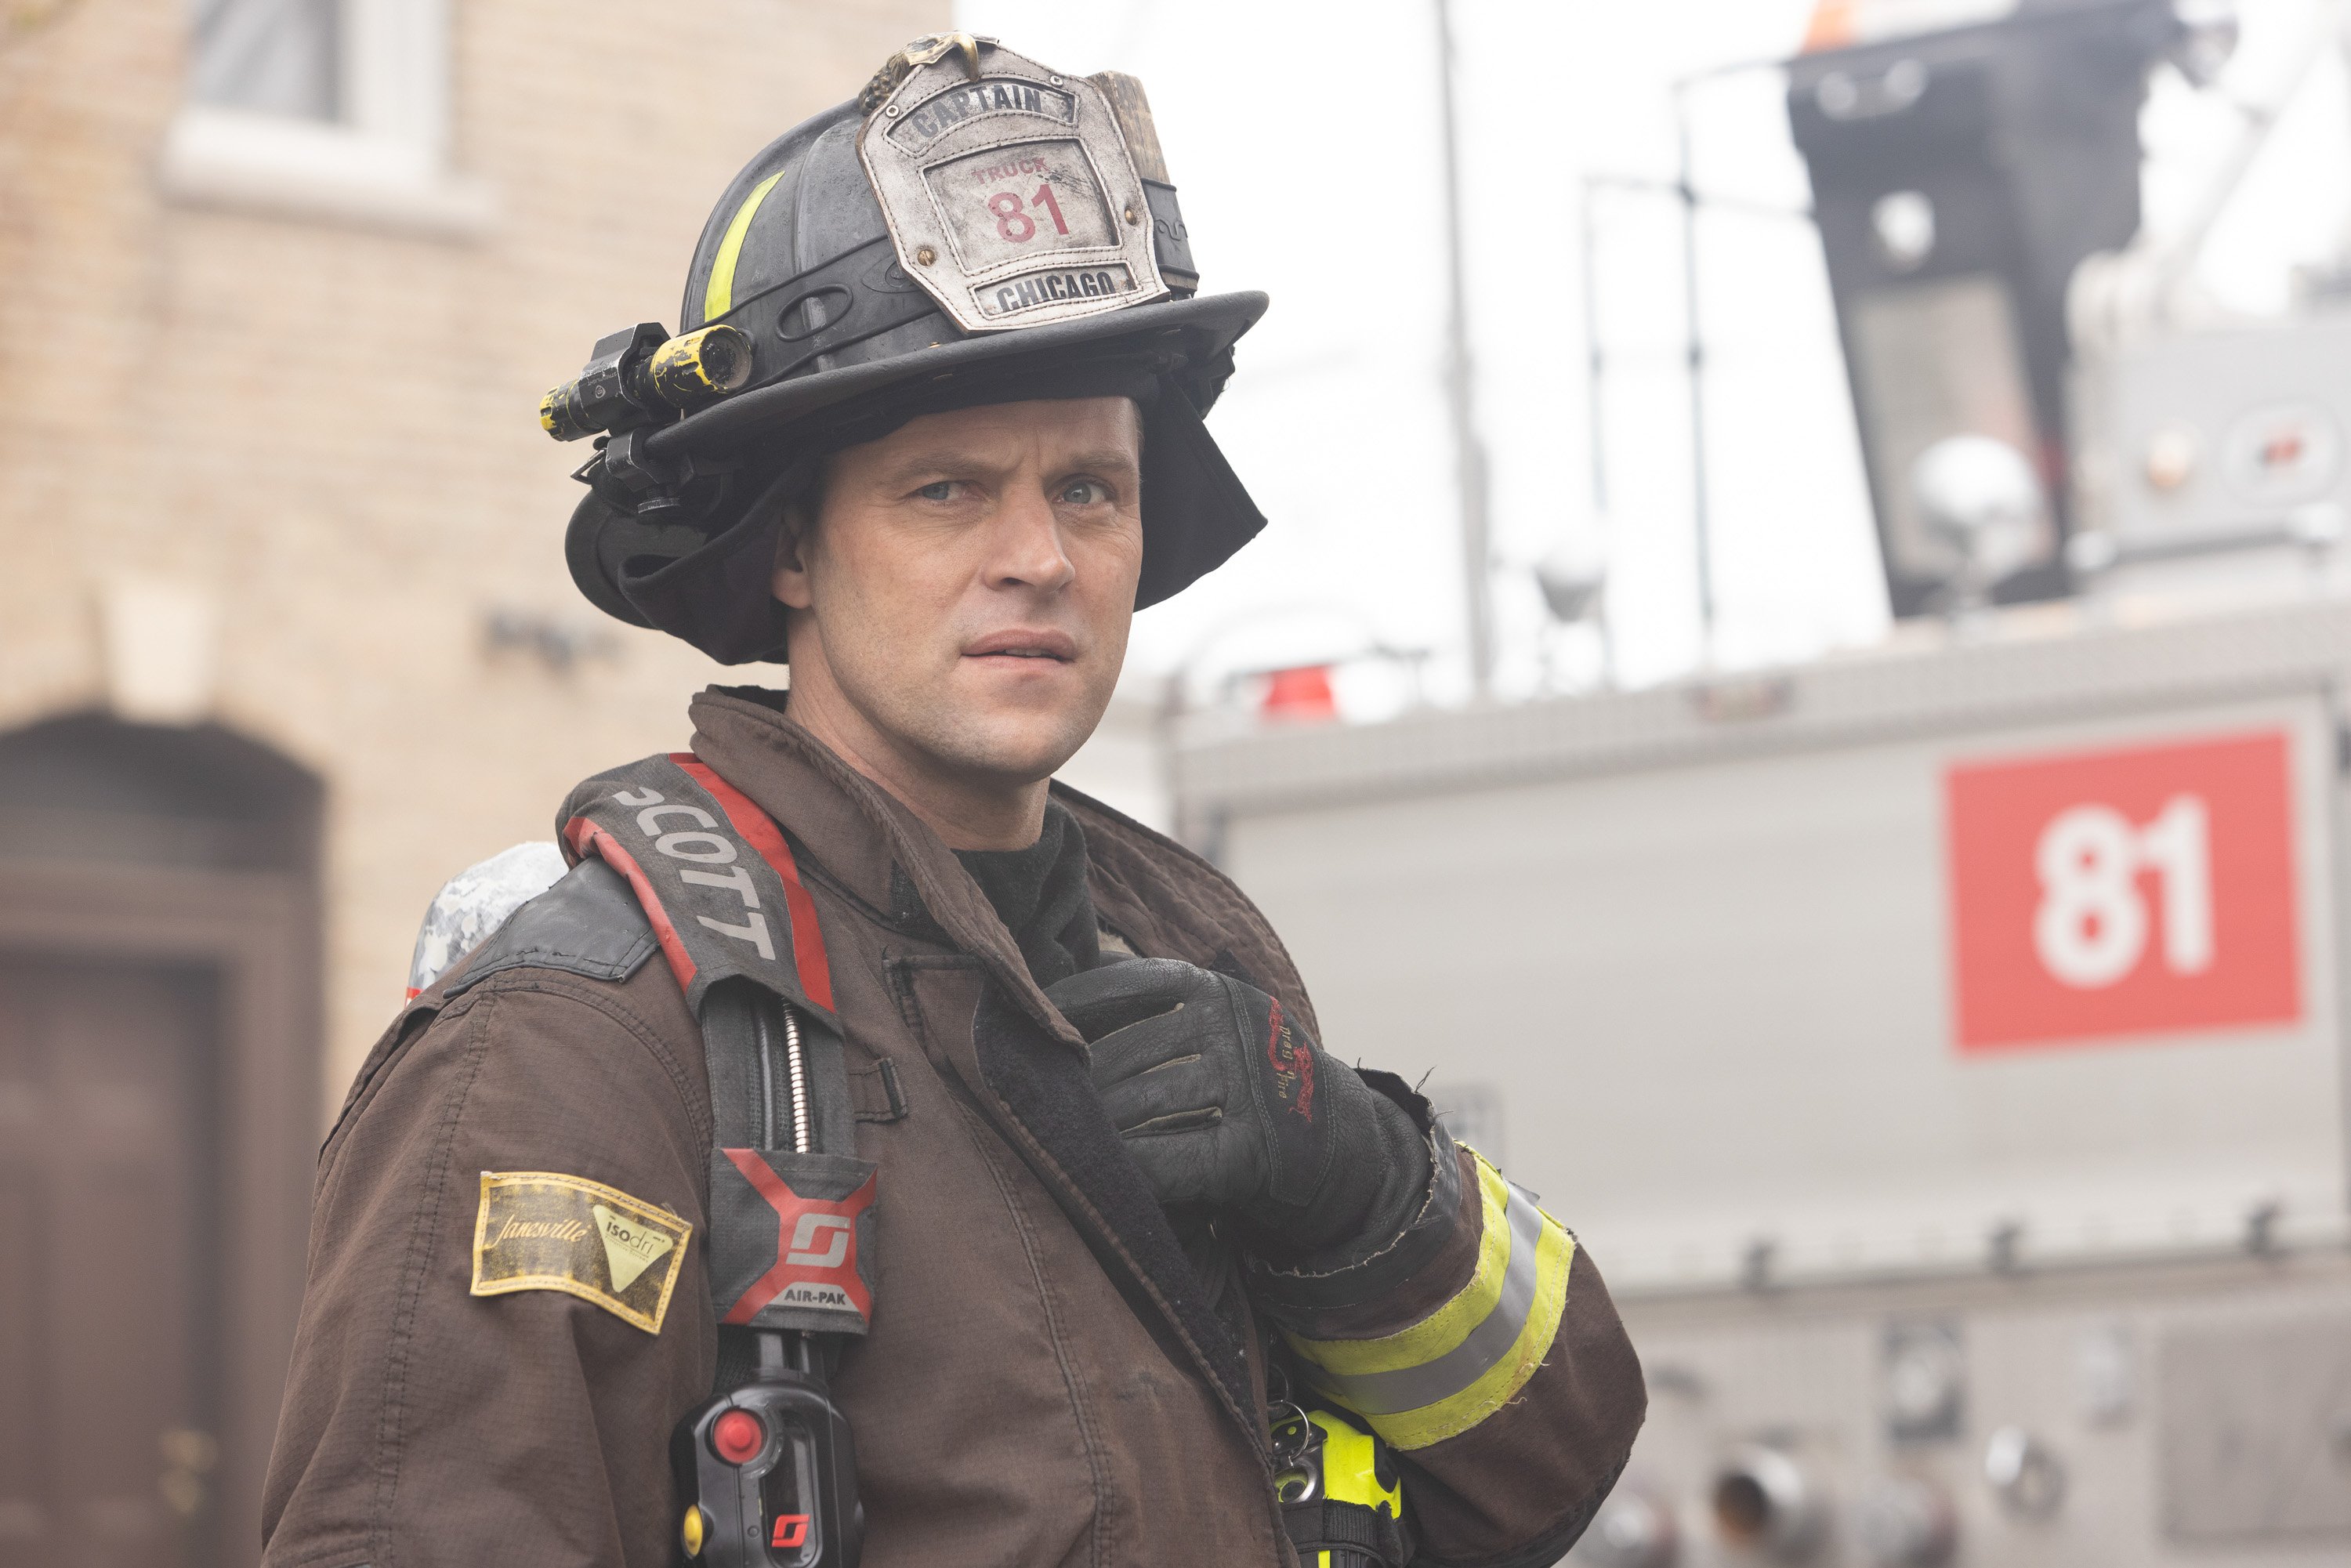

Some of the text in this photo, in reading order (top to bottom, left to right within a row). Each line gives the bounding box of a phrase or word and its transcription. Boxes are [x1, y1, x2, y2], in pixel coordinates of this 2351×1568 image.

[911, 83, 1042, 138] CAPTAIN
[972, 158, 1049, 185] TRUCK
[987, 184, 1070, 243] 81
[997, 271, 1115, 313] CHICAGO
[2035, 795, 2215, 989] 81
[482, 1215, 587, 1250] Janesville
[784, 1288, 846, 1305] AIR-PAK
